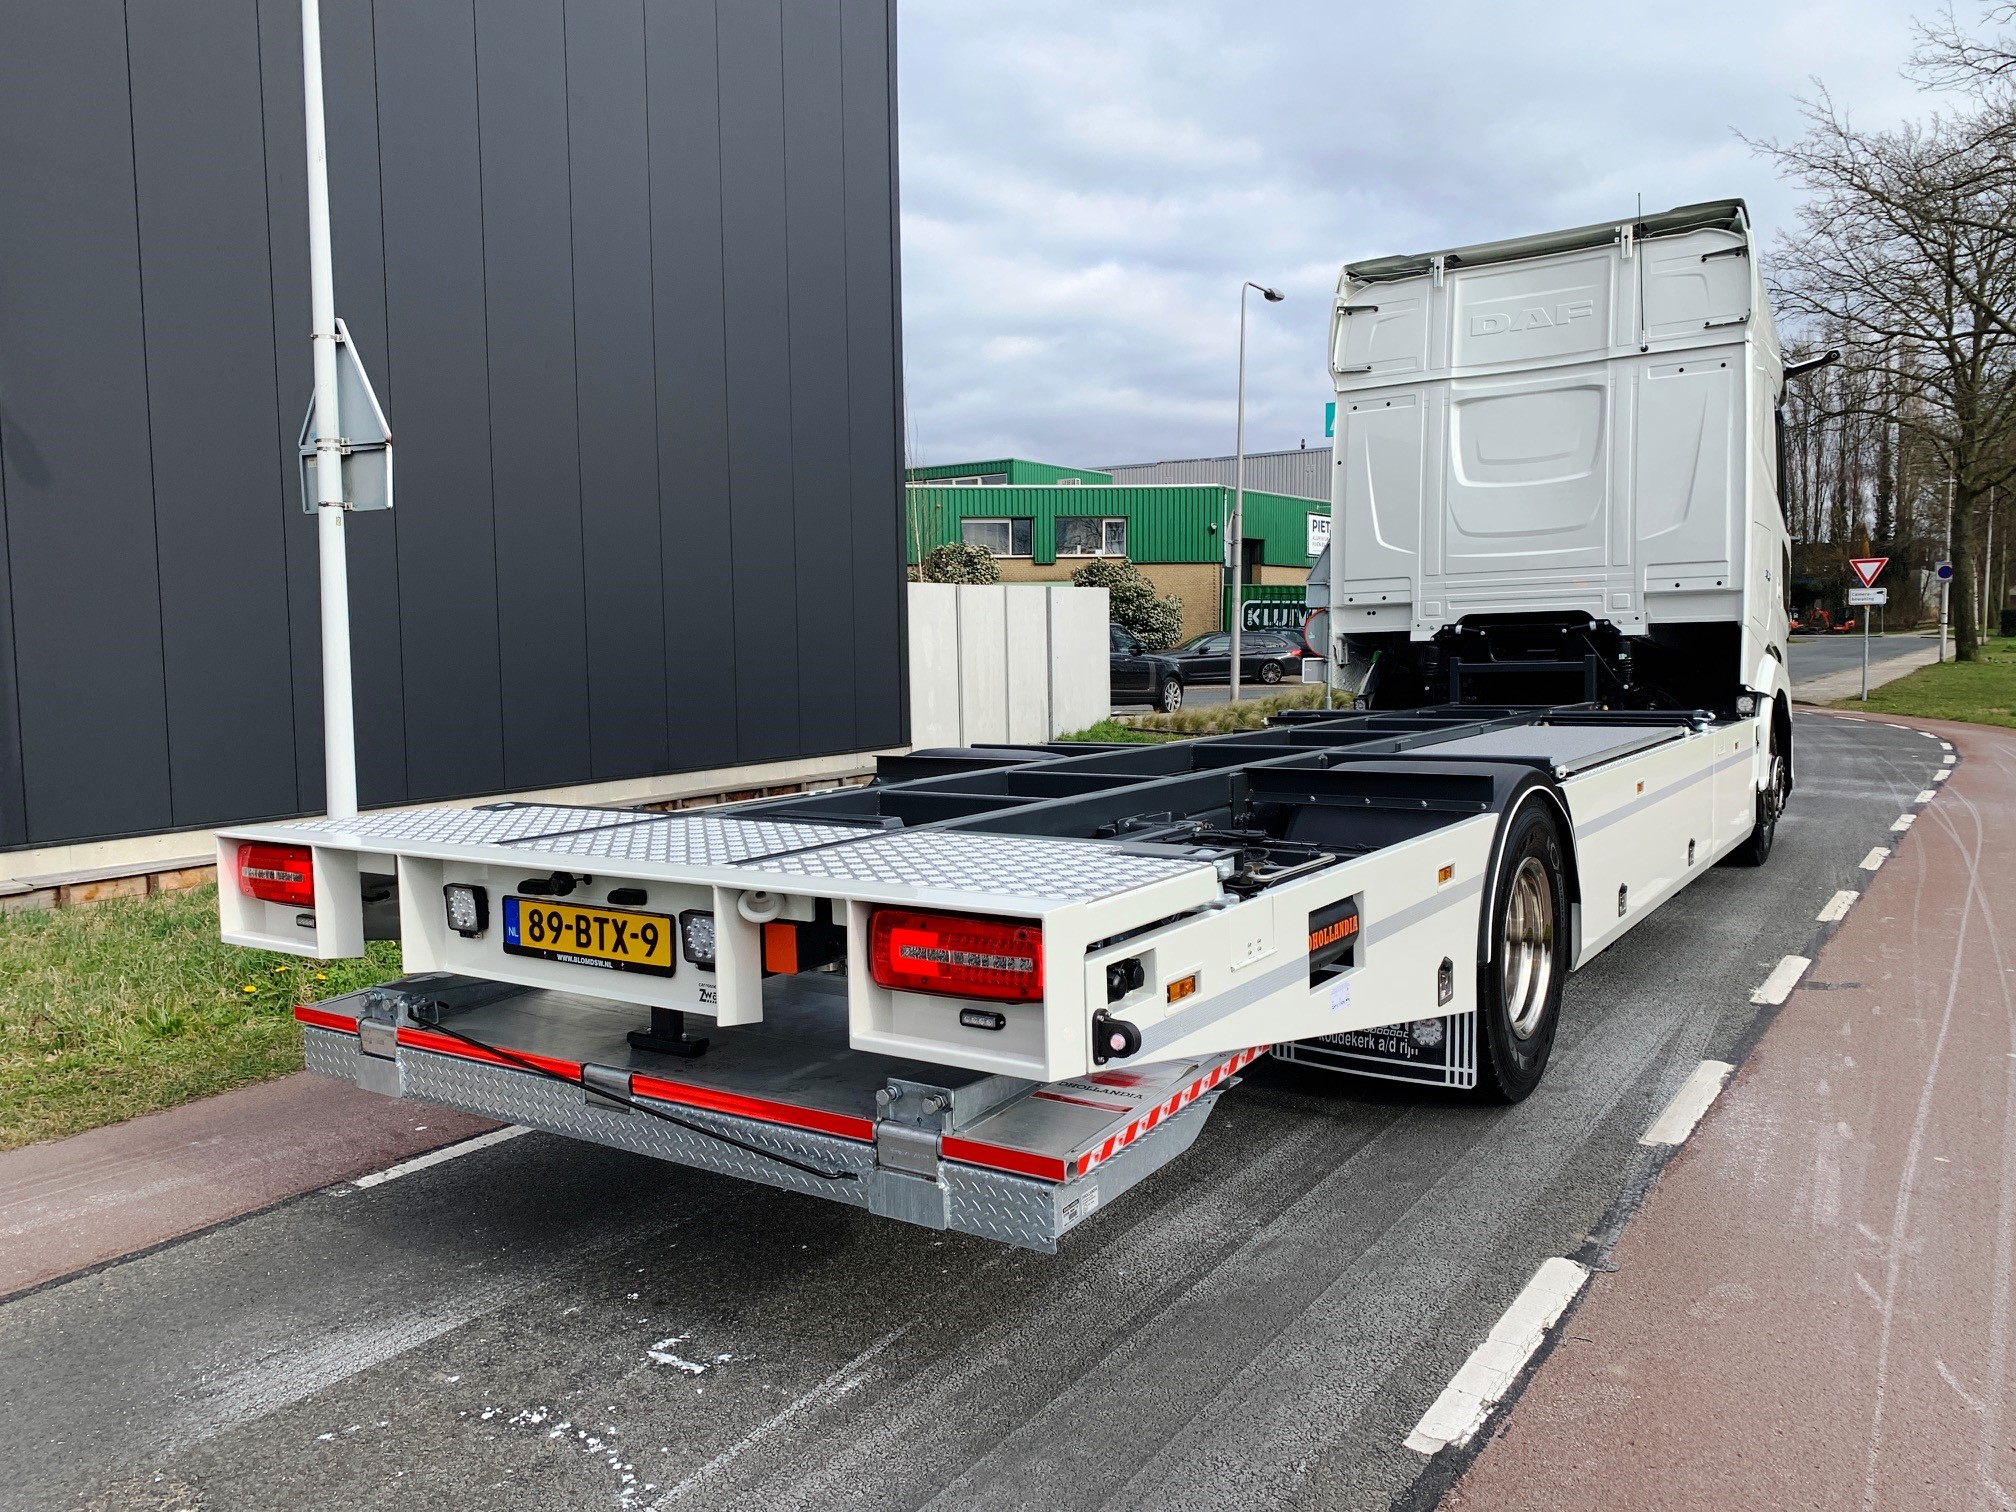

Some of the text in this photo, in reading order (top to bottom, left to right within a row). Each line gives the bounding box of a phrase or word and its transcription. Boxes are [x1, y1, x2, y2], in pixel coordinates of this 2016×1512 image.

[1470, 300, 1594, 337] DAF
[1312, 519, 1331, 533] PIET
[1252, 608, 1318, 626] KLUIV
[508, 926, 519, 938] NL
[528, 908, 659, 958] 89-BTX-9
[556, 953, 613, 968] WWW.BLOMDSW.NL
[1378, 1036, 1397, 1053] a/d
[1057, 1080, 1143, 1100] DHOLLANDIA
